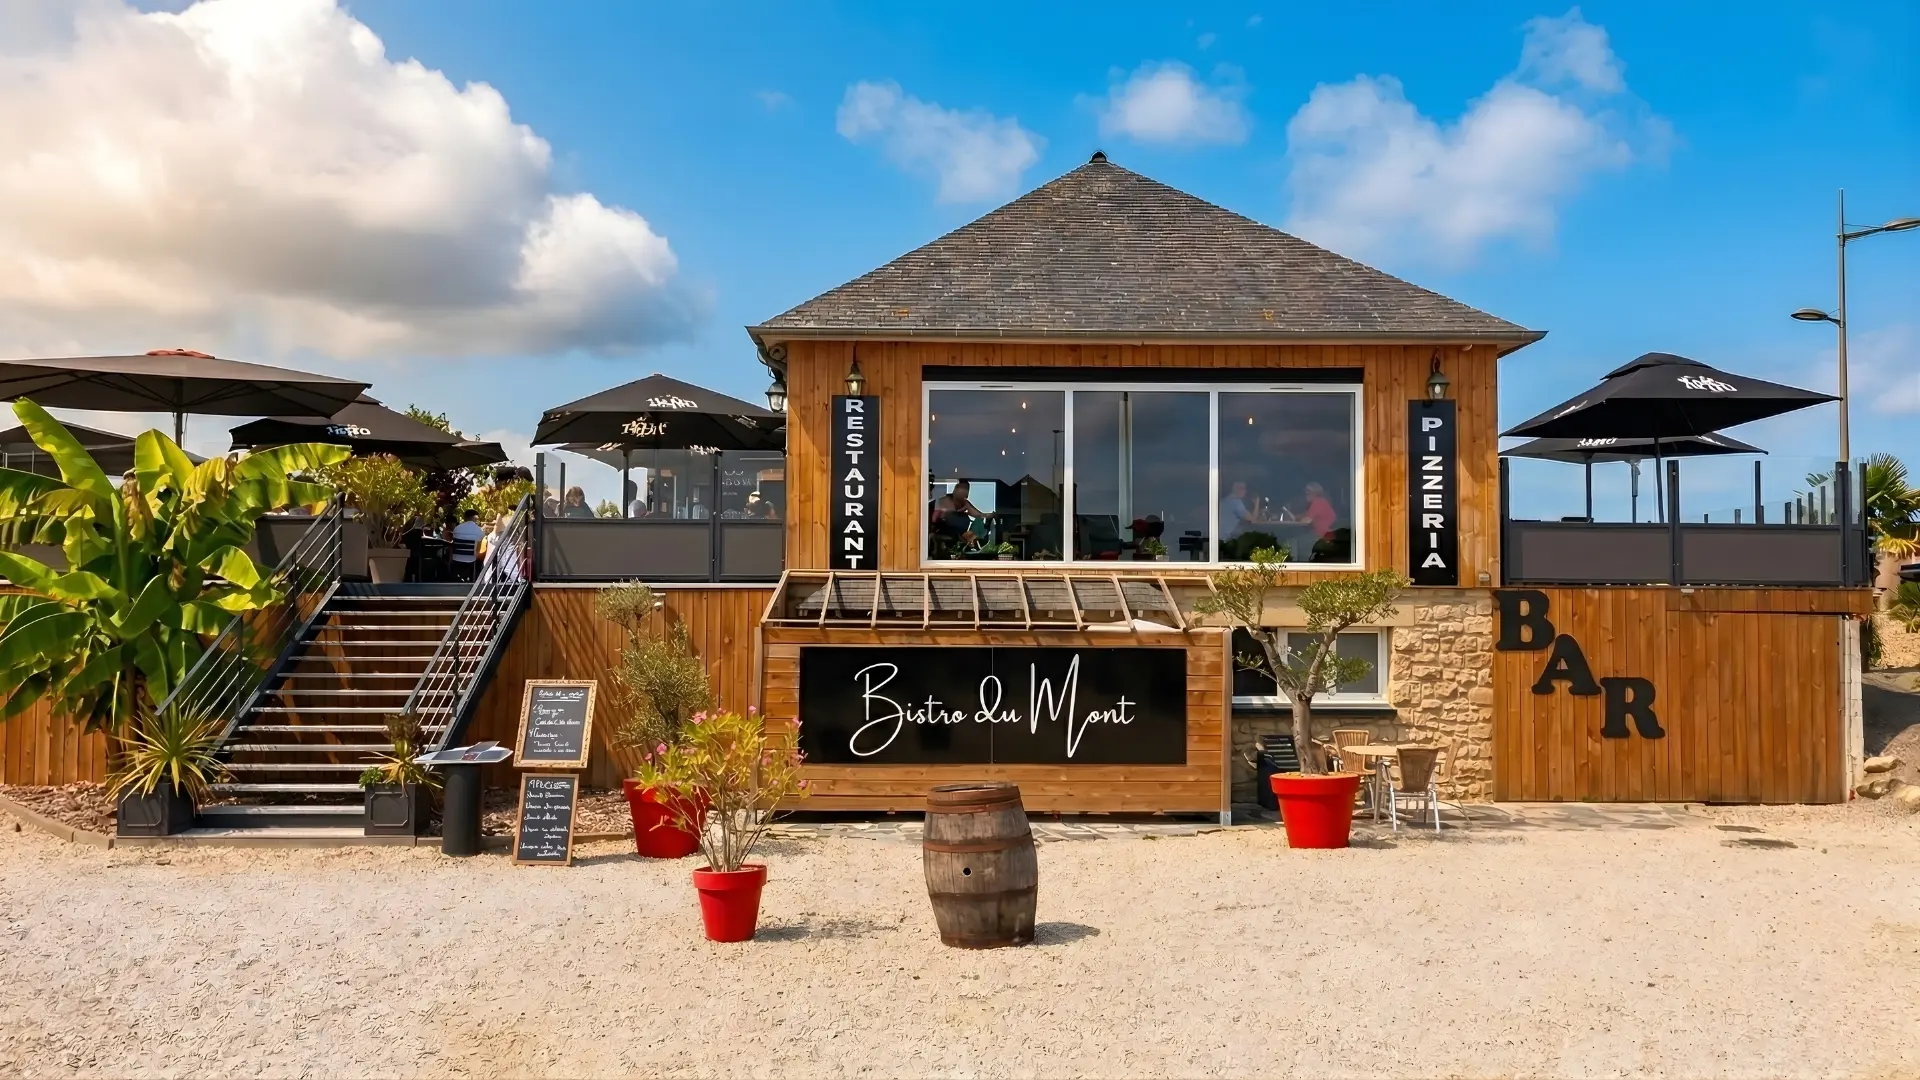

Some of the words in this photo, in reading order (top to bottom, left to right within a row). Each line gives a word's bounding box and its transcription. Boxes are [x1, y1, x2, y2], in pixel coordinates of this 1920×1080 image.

[844, 399, 866, 569] RESTAURANT
[1421, 417, 1447, 569] PIZZERIA
[849, 662, 968, 757] Bistro
[974, 675, 1022, 724] du
[1030, 653, 1137, 758] Mont
[1496, 590, 1665, 739] BAR
